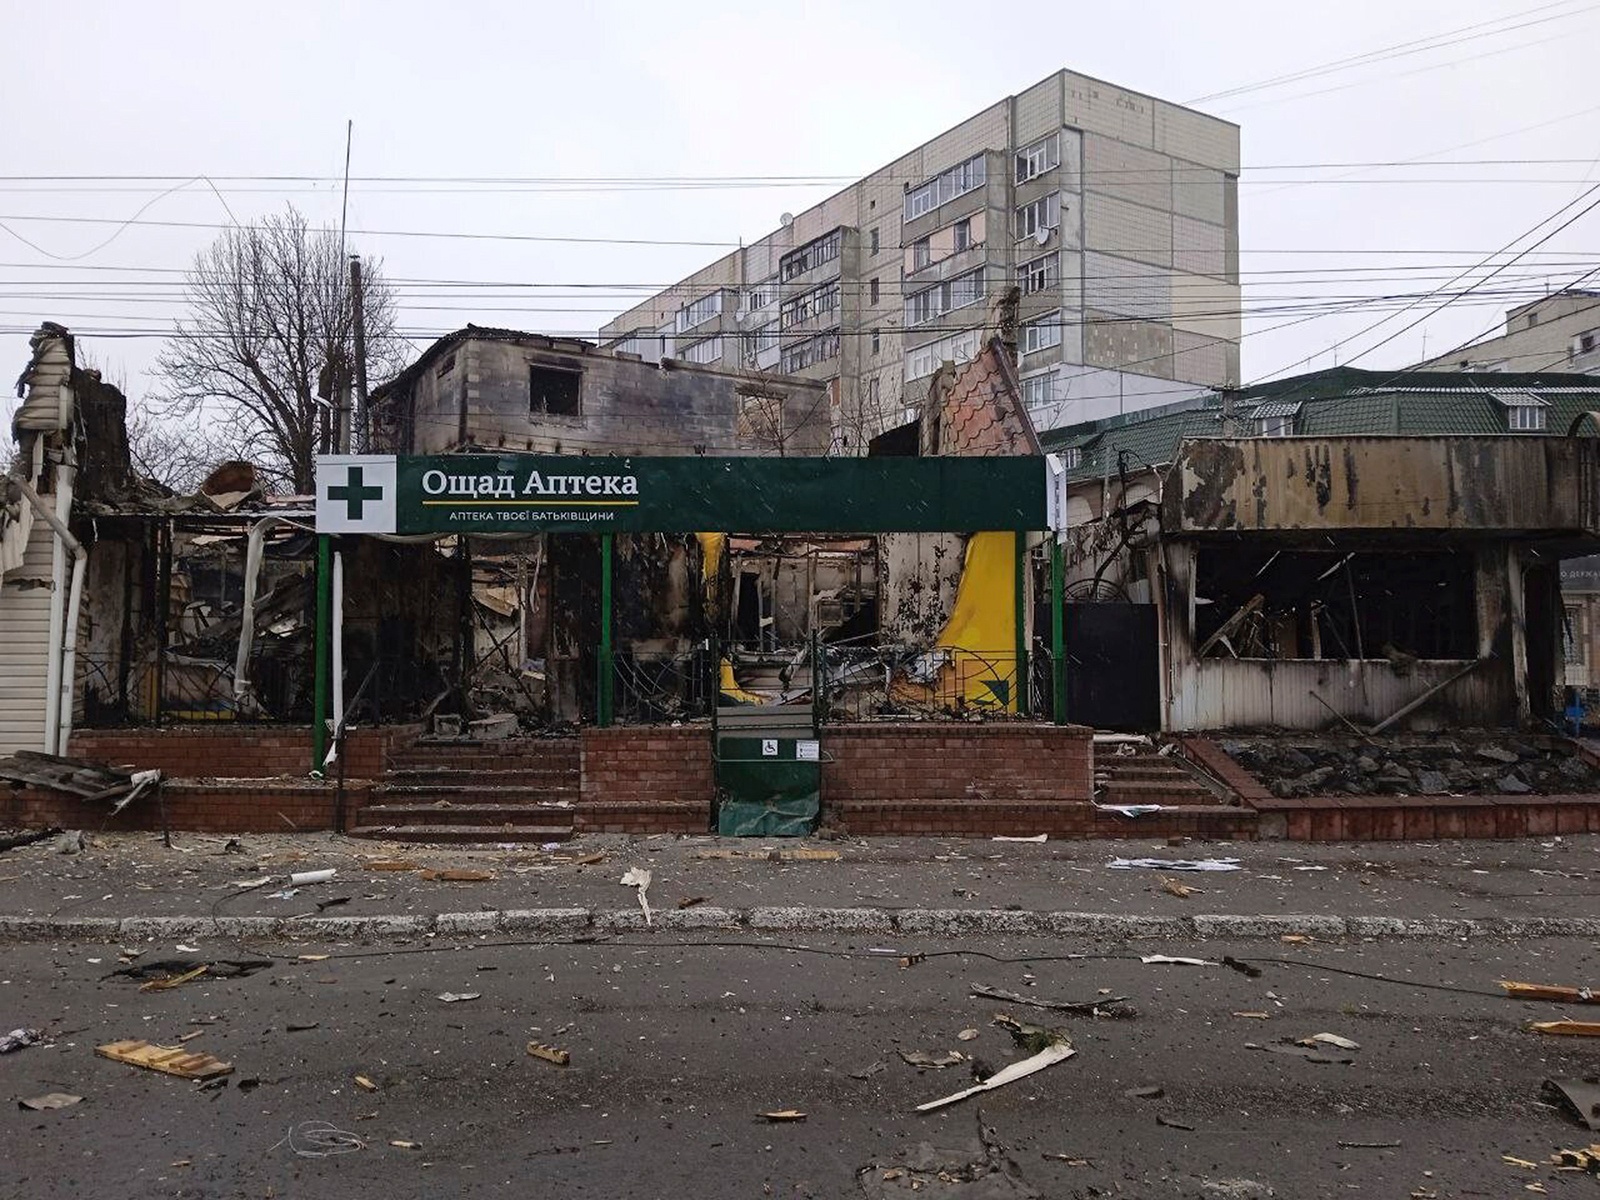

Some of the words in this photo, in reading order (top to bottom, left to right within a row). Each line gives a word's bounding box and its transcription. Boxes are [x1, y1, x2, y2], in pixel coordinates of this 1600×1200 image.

[422, 470, 515, 498] Ощад
[522, 470, 639, 495] Аптека
[449, 511, 494, 521] АПТЕКА
[496, 509, 531, 521] ТВОЄЇ
[532, 511, 615, 522] БАТЬКІВЩИНИ
